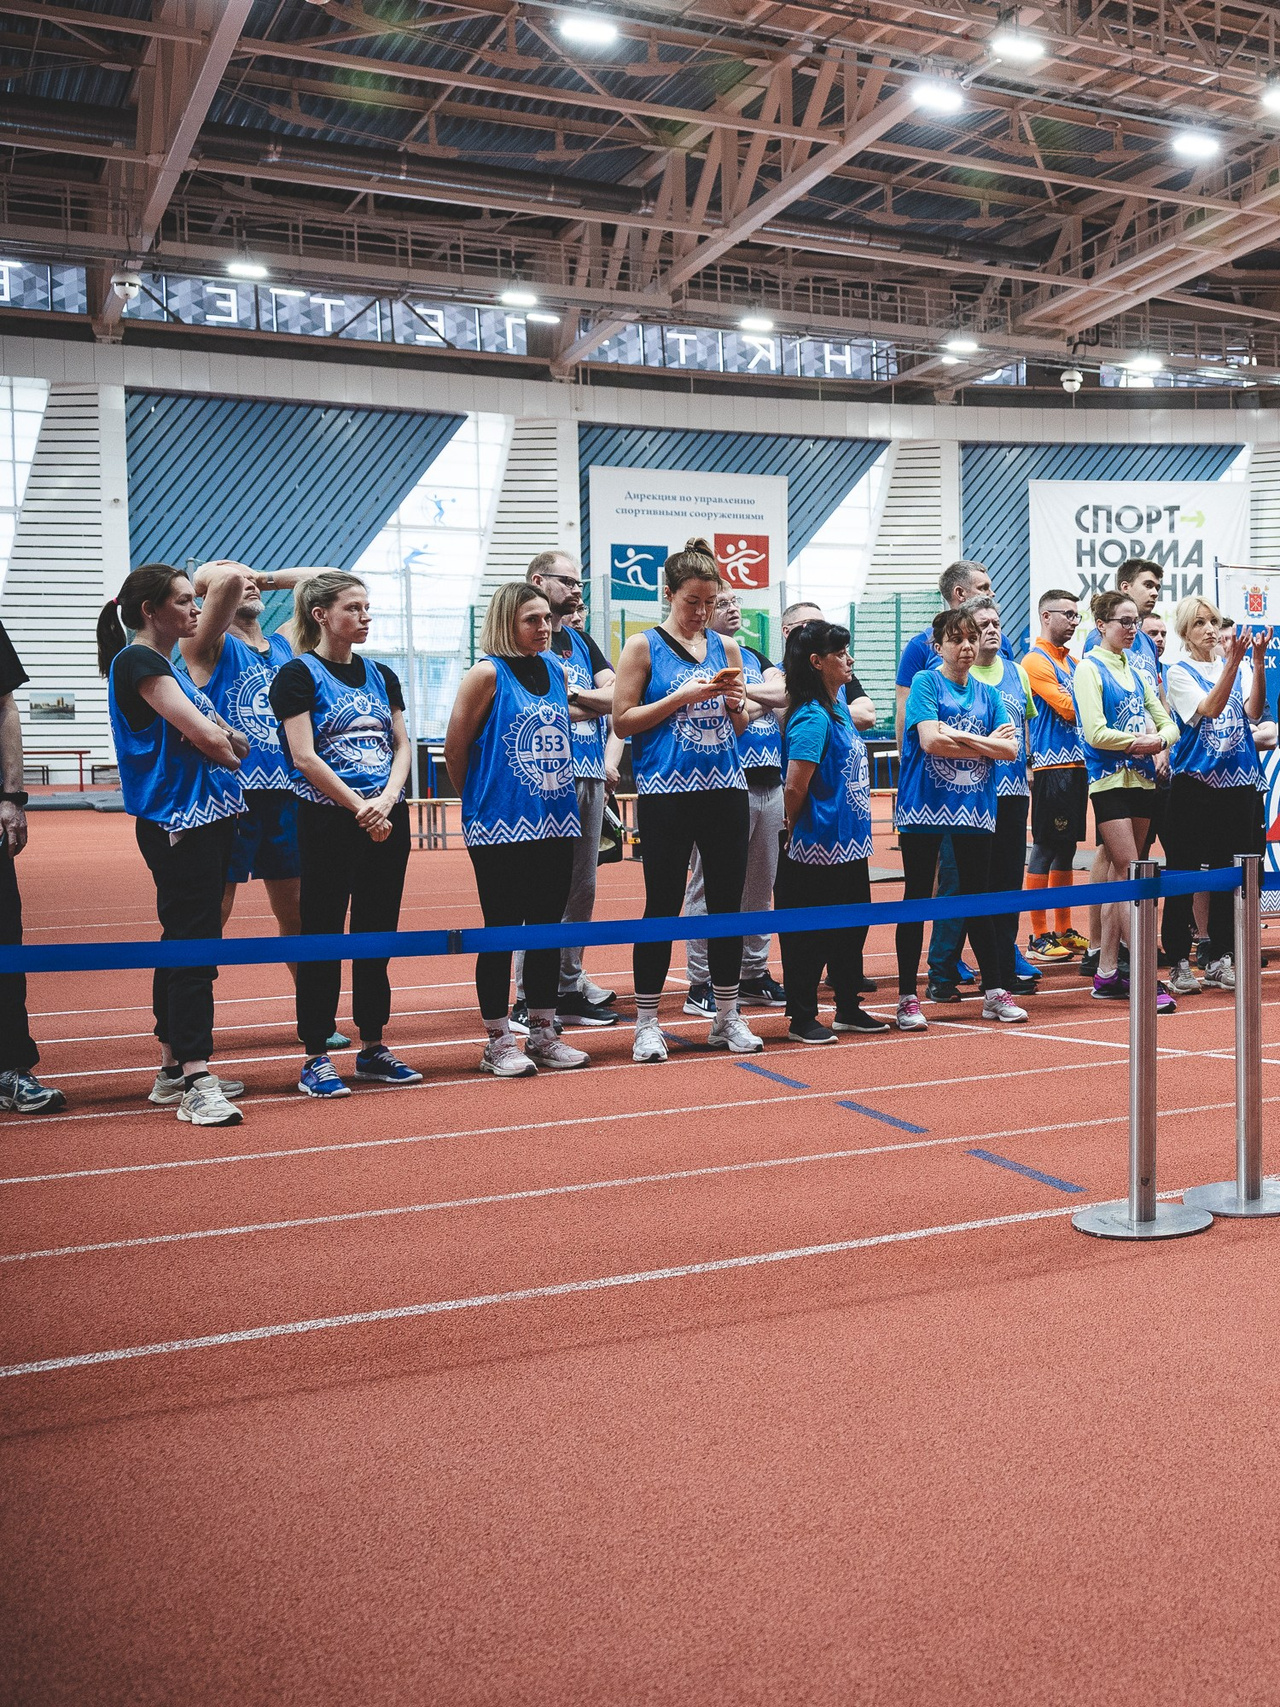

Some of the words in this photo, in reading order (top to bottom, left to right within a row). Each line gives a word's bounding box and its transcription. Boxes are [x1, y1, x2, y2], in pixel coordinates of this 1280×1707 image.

[624, 490, 677, 503] Дирекция
[679, 494, 693, 502] по
[694, 495, 756, 506] управлению
[615, 506, 688, 517] спортивными
[689, 510, 765, 521] сооружениями
[1075, 504, 1180, 534] СПОРТ
[1076, 539, 1203, 568] НОРМА
[1077, 573, 1203, 602] ЖНИ
[698, 717, 720, 728] ГТО
[1215, 708, 1234, 725] 94
[1217, 727, 1232, 737] ГТО
[356, 737, 378, 748] ГТО
[534, 734, 565, 753] 353
[540, 759, 560, 770] ГТО
[954, 759, 975, 769] ГТО
